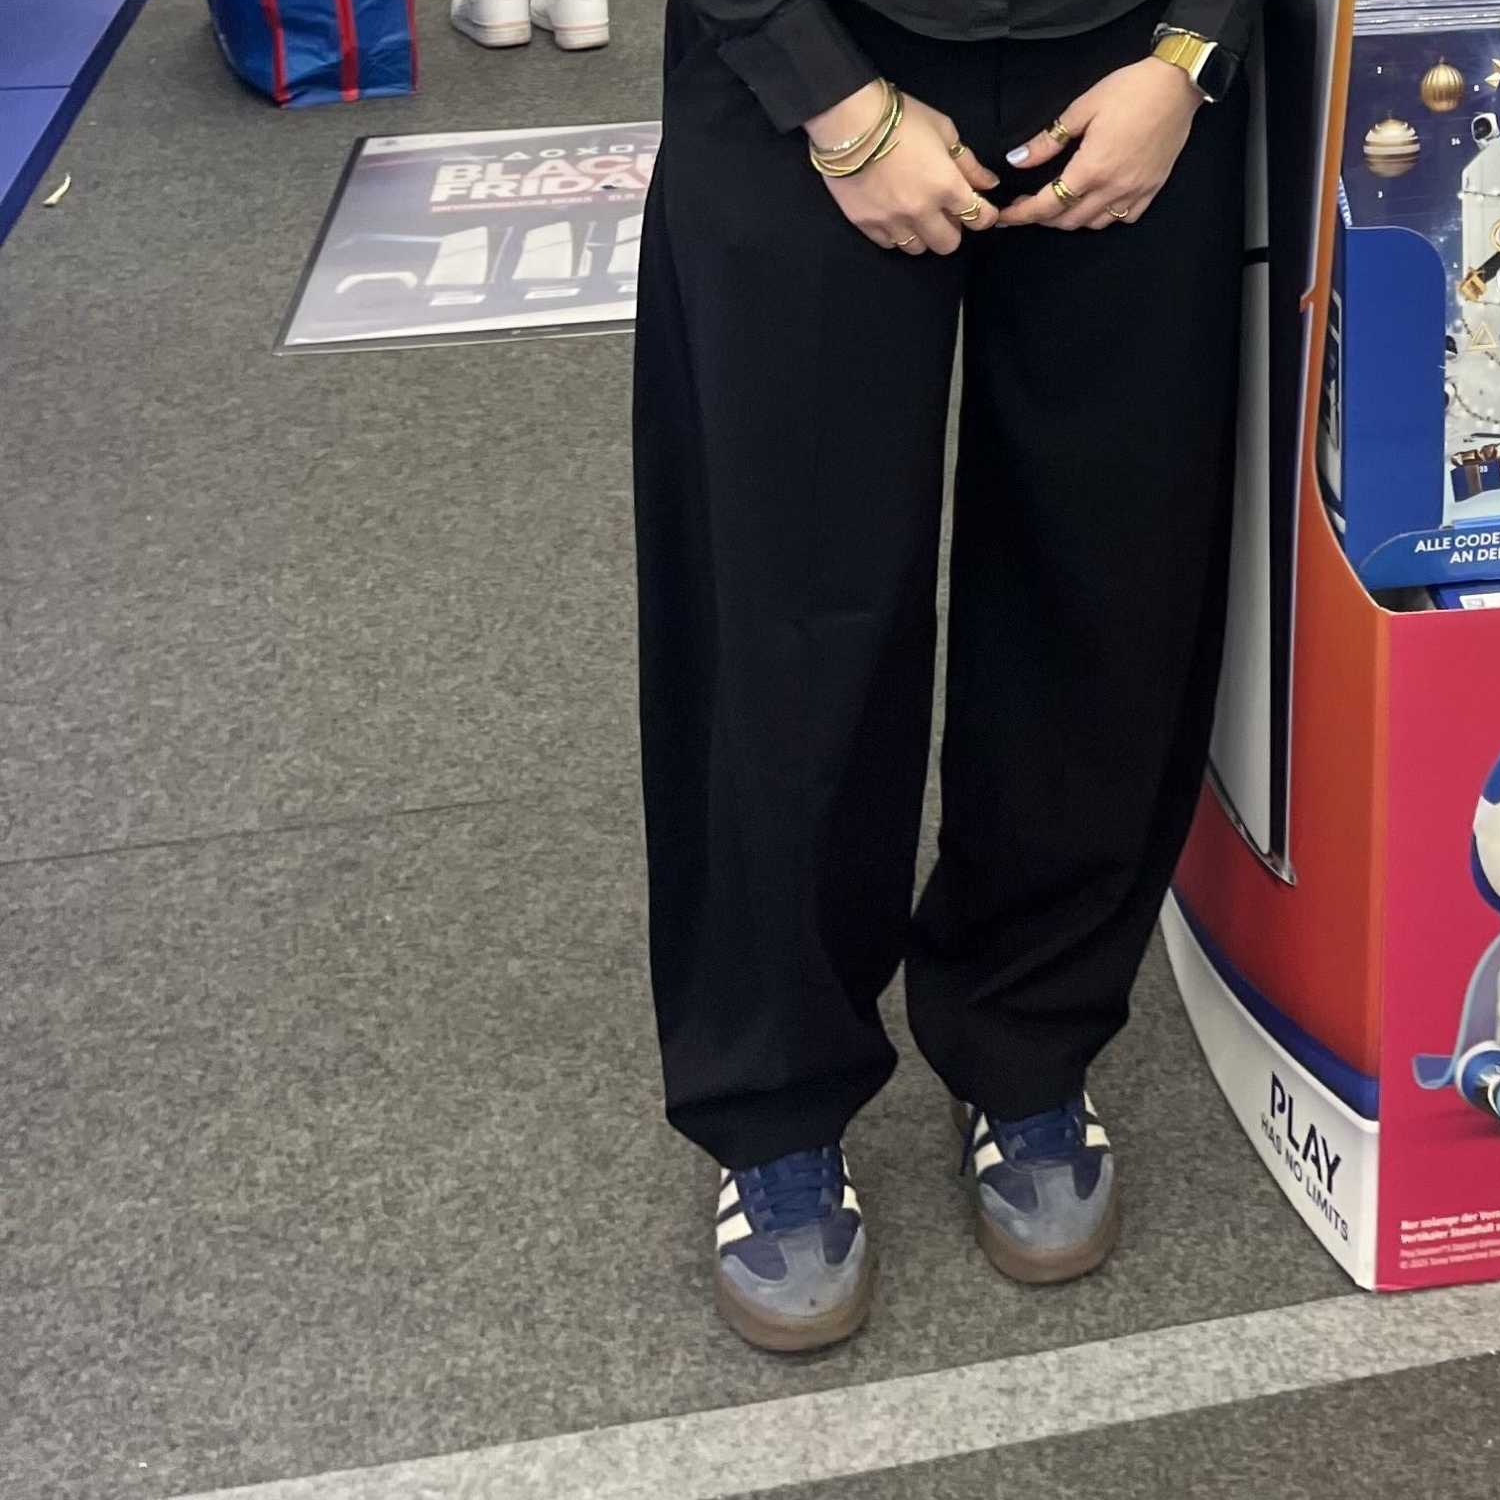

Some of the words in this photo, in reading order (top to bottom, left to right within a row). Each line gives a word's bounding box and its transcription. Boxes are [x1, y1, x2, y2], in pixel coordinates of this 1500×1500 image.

[430, 172, 646, 203] FRIDA
[1415, 537, 1451, 553] ALLE
[1450, 550, 1473, 564] AN
[1270, 1070, 1342, 1195] PLAY
[1261, 1112, 1282, 1155] HAS
[1285, 1148, 1303, 1183] NO
[1306, 1176, 1349, 1242] LIMITS
